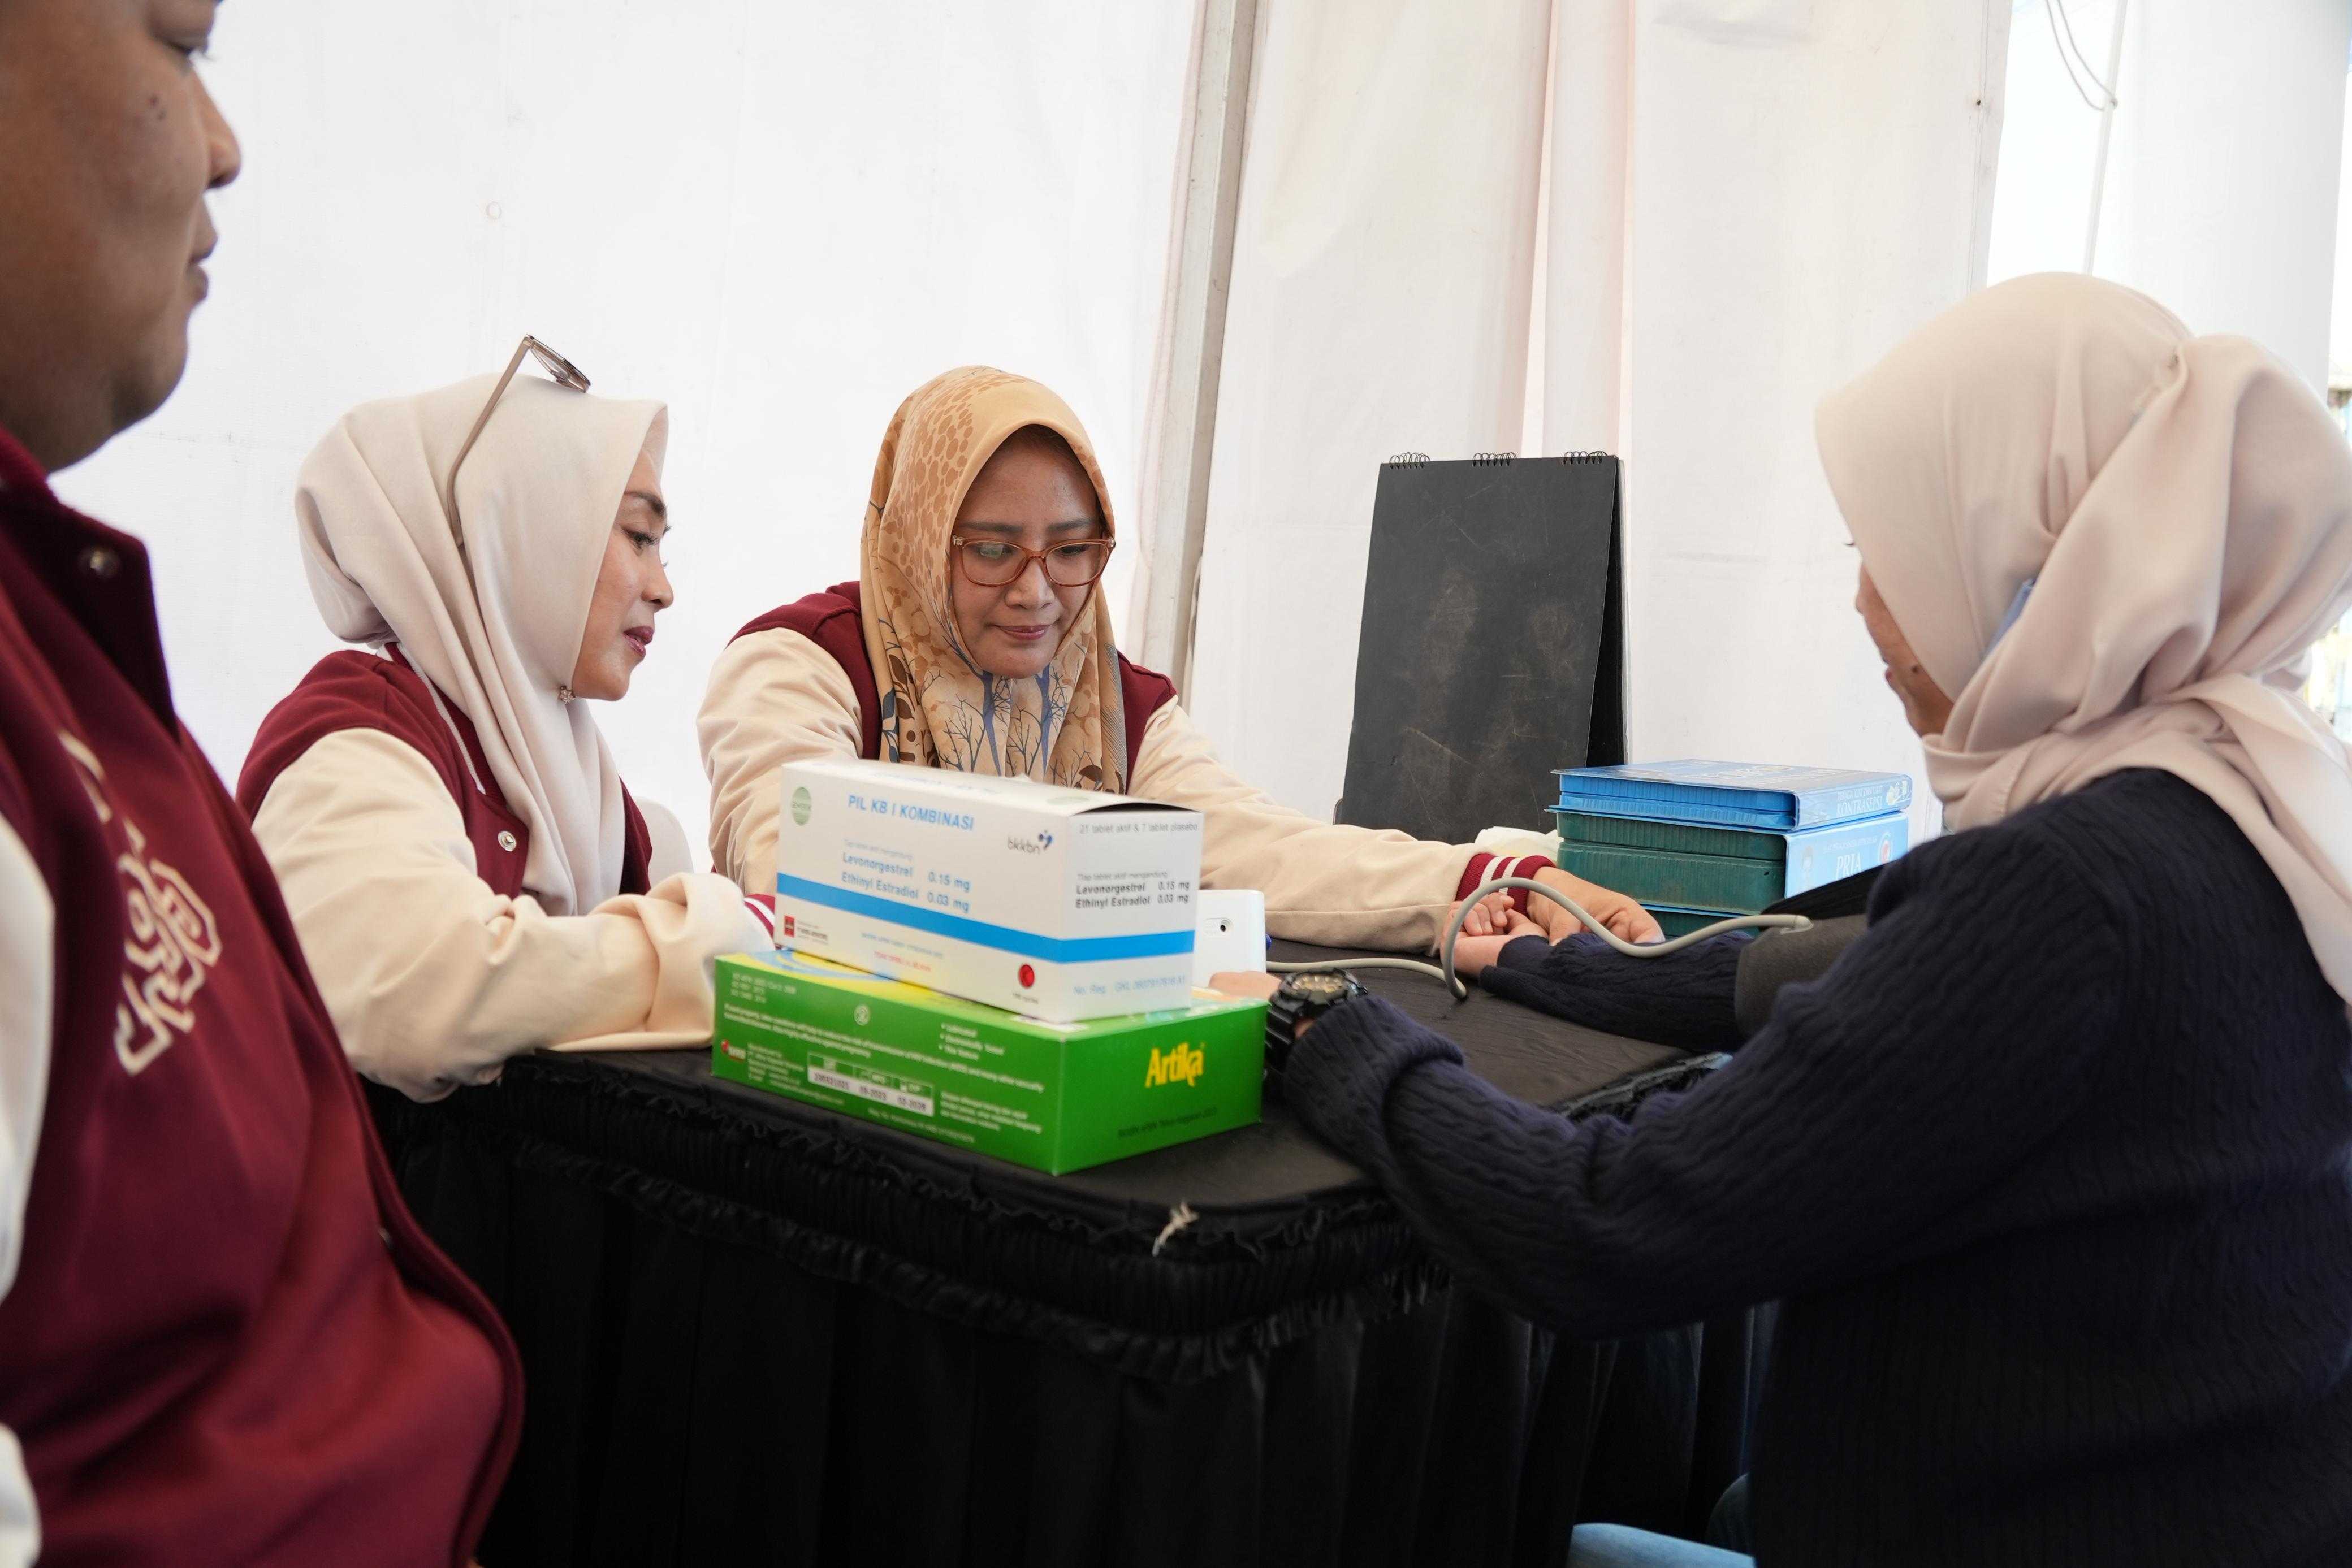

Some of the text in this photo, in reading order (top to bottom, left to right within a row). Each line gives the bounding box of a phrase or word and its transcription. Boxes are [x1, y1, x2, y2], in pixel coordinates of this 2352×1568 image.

[849, 795, 866, 811] PIL
[871, 799, 888, 814] KB
[900, 805, 974, 830] KOMBINASI
[1079, 824, 1088, 834] 21
[1092, 824, 1113, 833] tablet
[1116, 823, 1131, 833] aktif
[1134, 824, 1139, 832] &
[1148, 823, 1168, 832] tablet
[1170, 822, 1197, 833] plasebo
[1007, 835, 1040, 854] bkkbn
[842, 852, 970, 893] Levonorgestrel 0.15 mg
[1836, 852, 1862, 880] PRIA
[842, 872, 969, 913] Ethinyl Estradiol 0.03 mg
[1075, 894, 1188, 909] Ethinyl Estradiol 0.03 mg
[1076, 881, 1190, 895] Levonorgestrel 0.15 mg
[1145, 1042, 1204, 1088] Artika
